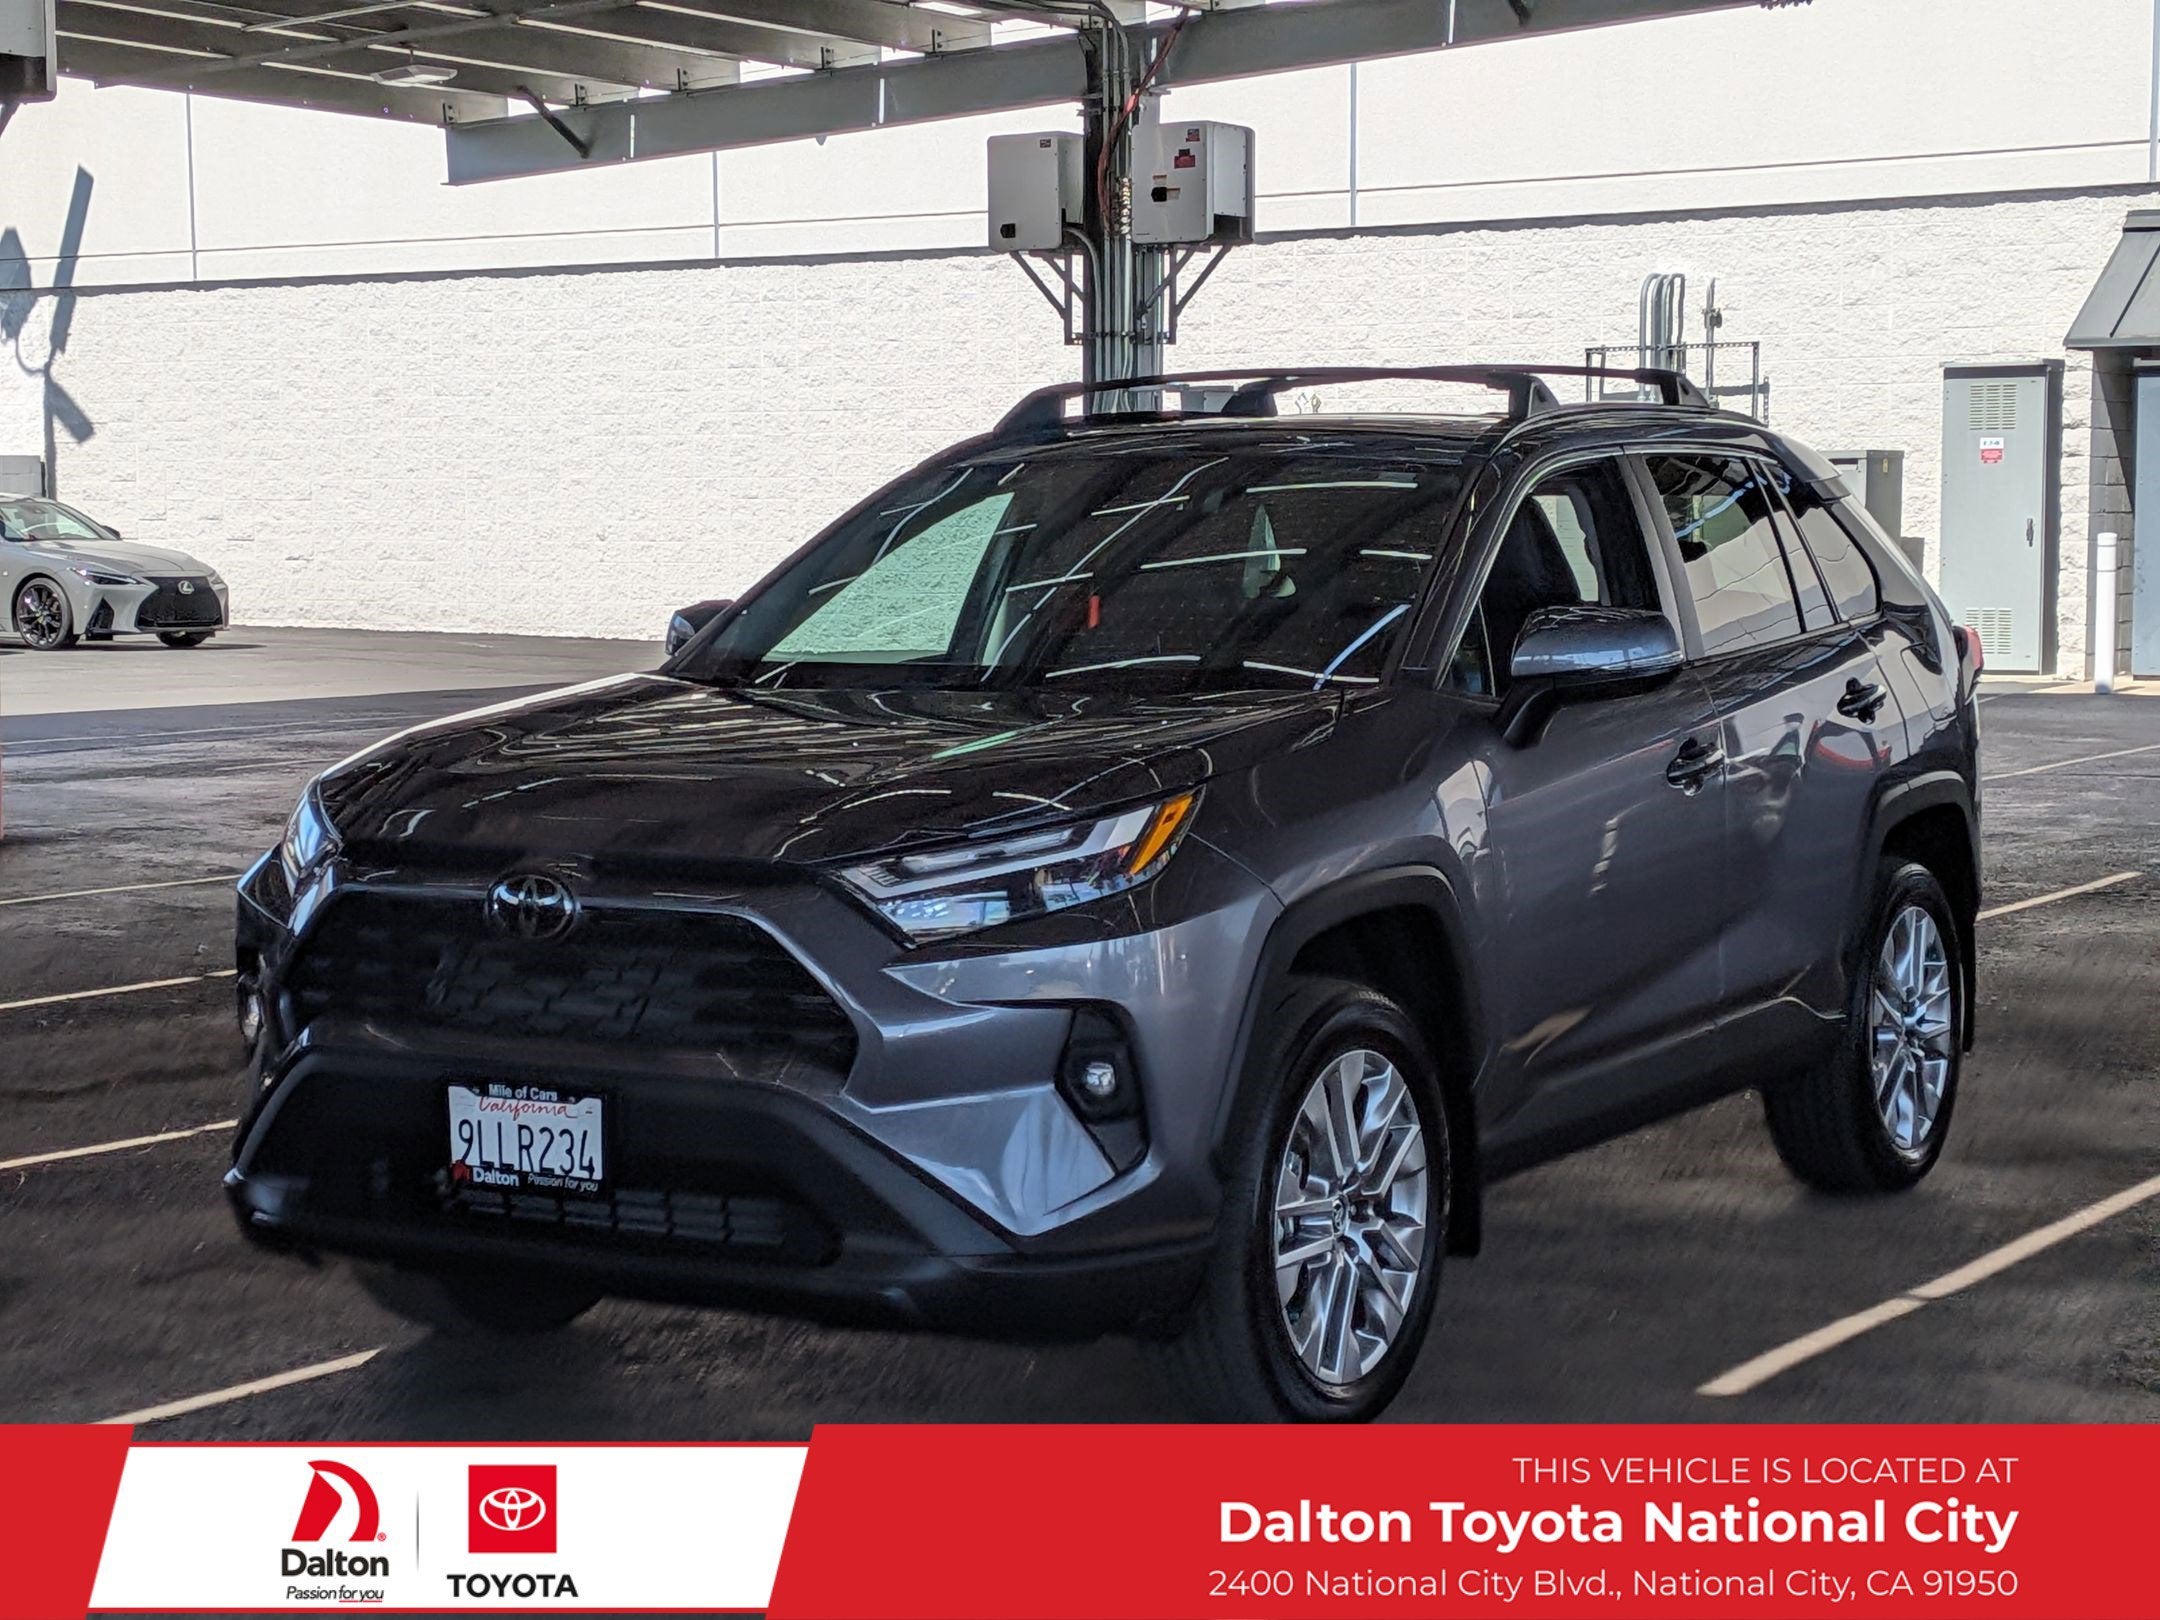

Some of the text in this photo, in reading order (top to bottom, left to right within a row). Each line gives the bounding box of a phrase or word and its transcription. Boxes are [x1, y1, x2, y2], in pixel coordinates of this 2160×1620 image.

[488, 1083, 557, 1101] Mile of Cars
[458, 1119, 595, 1178] 9LLR234
[473, 1168, 599, 1193] Dalton Passion for you
